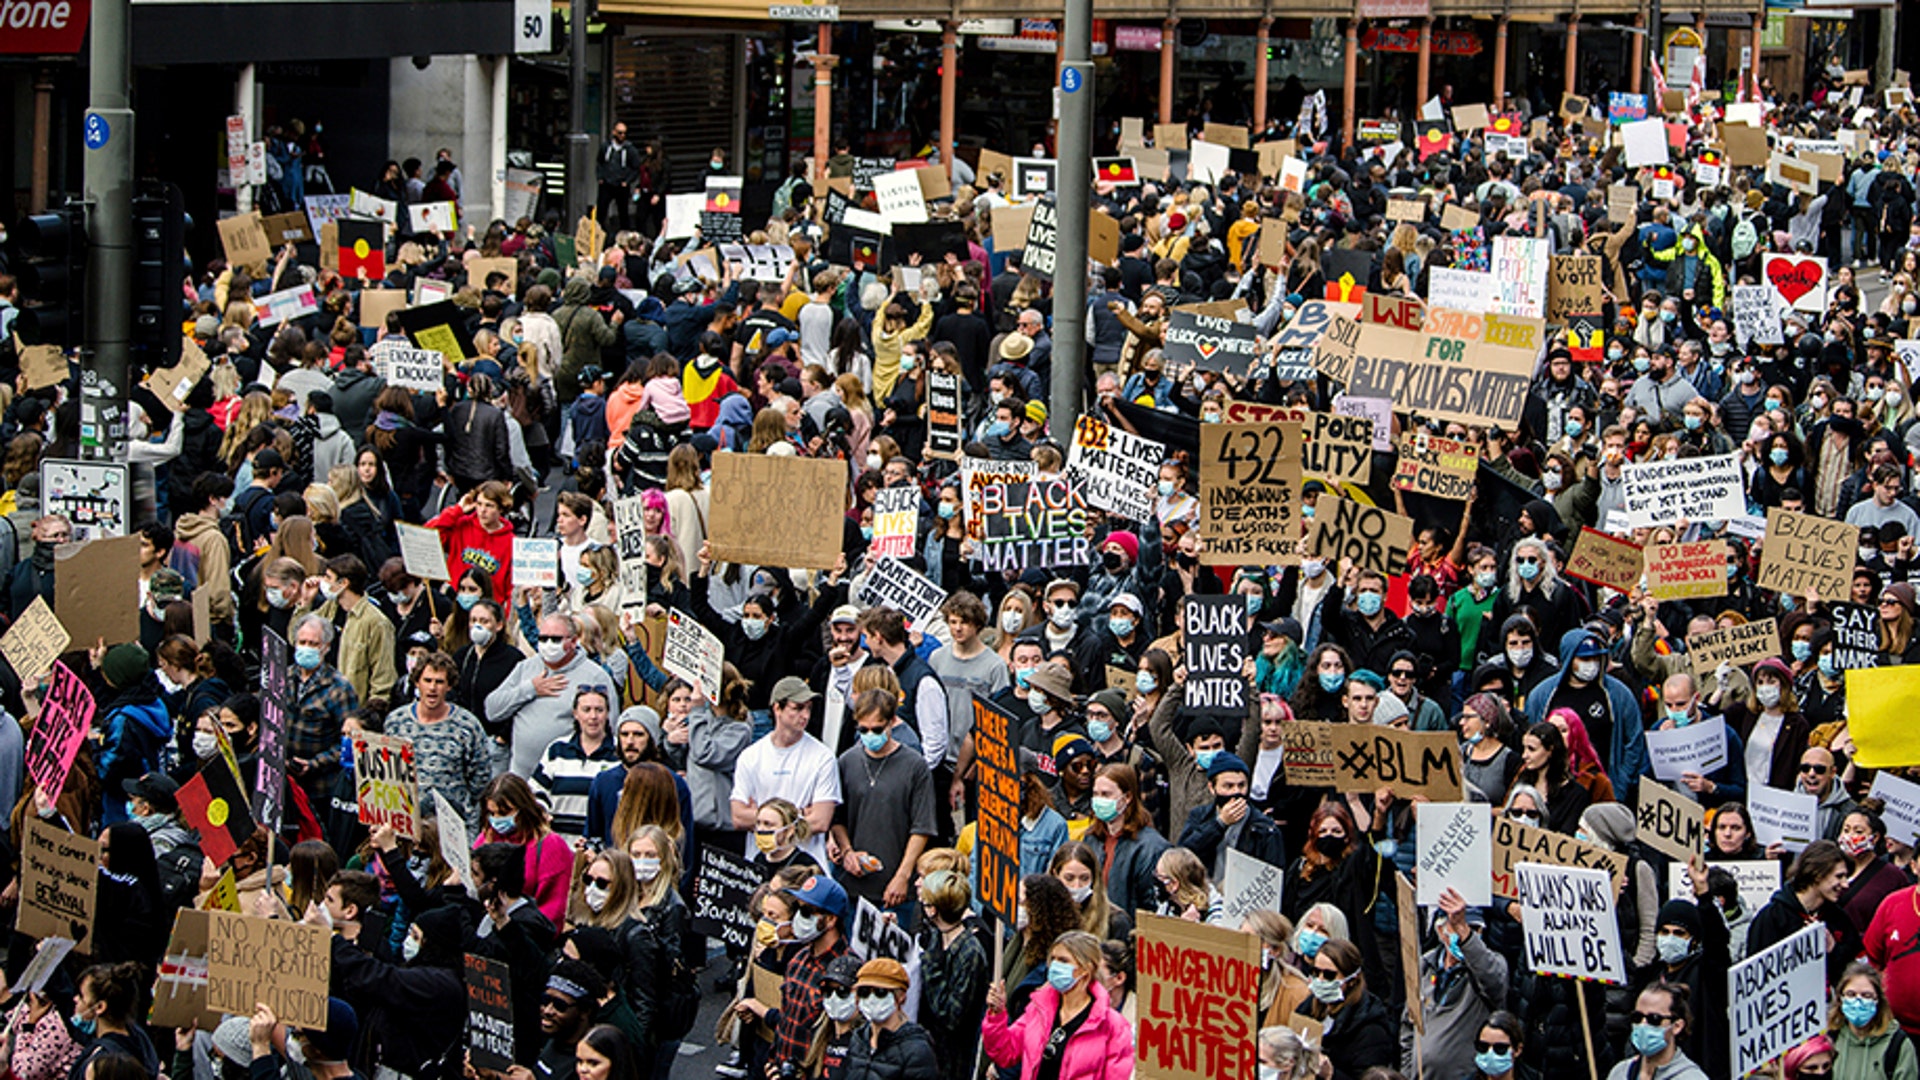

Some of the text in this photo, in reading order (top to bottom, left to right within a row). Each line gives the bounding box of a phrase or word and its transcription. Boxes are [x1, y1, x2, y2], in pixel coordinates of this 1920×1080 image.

[523, 15, 542, 38] 50
[1555, 257, 1597, 275] YOUR
[1195, 315, 1233, 334] LIVES
[1372, 295, 1422, 332] WE
[1424, 306, 1482, 340] STAND
[389, 350, 441, 366] ENOUGH IS
[1426, 336, 1467, 363] FOR
[395, 366, 440, 382] ENOUGH
[1120, 435, 1164, 467] LIVES
[1219, 426, 1287, 486] 432
[1428, 437, 1460, 454] STOP
[1623, 457, 1734, 484] I UNDERSTAND THAT
[875, 488, 920, 513] BLACK
[981, 480, 1088, 515] BLACK
[1626, 485, 1635, 497] I
[1628, 486, 1729, 511] BUT YET I STAND
[874, 510, 916, 536] LIVES
[1110, 494, 1150, 523] MATTER
[1209, 507, 1291, 521] DEATHS
[1333, 498, 1388, 543] NO
[982, 508, 1088, 544] LIVES
[1209, 522, 1223, 534] IN
[1773, 512, 1850, 549] BLACK
[872, 534, 914, 559] MATTER
[983, 537, 1090, 572] MATTER
[1315, 521, 1410, 580] MORE
[1659, 545, 1678, 561] DO
[1784, 540, 1847, 571] LIVES
[877, 556, 912, 586] SAME
[1660, 568, 1717, 584] MAKE YOU
[1761, 558, 1846, 599] MATTER
[1186, 602, 1244, 637] BLACK
[1831, 606, 1876, 630] SAY
[1689, 620, 1774, 651] WHITE SILENCE
[1710, 637, 1769, 662] VIOLENCE
[1836, 628, 1878, 651] THEIR
[1186, 643, 1243, 673] LIVES
[1185, 677, 1244, 708] MATTER
[358, 748, 416, 784] JUSTICE
[975, 731, 1017, 775] COMES A
[374, 782, 401, 809] FOR
[1419, 806, 1473, 873] BLACK LIVES
[1434, 825, 1480, 878] MATTER
[1496, 821, 1597, 867] BLACK
[981, 844, 1018, 925] BLM
[1517, 870, 1607, 913] ALWAYS WAS
[216, 917, 319, 949] NO MORE
[1543, 911, 1599, 937] ALWAYS
[210, 938, 328, 983] BLACK DEATHS
[1528, 933, 1612, 973] WILL BE
[1734, 930, 1824, 1000] ABORIGINAL
[257, 969, 278, 984] IN
[1136, 935, 1261, 1005] INDIGENOUS
[208, 976, 328, 1028] POLICE CUSTODY
[1151, 982, 1250, 1038] LIVES
[1735, 980, 1792, 1037] LIVES
[470, 1010, 485, 1029] NO
[470, 1030, 485, 1049] NO
[1136, 1018, 1256, 1080] MATTER
[1738, 999, 1821, 1073] MATTER
